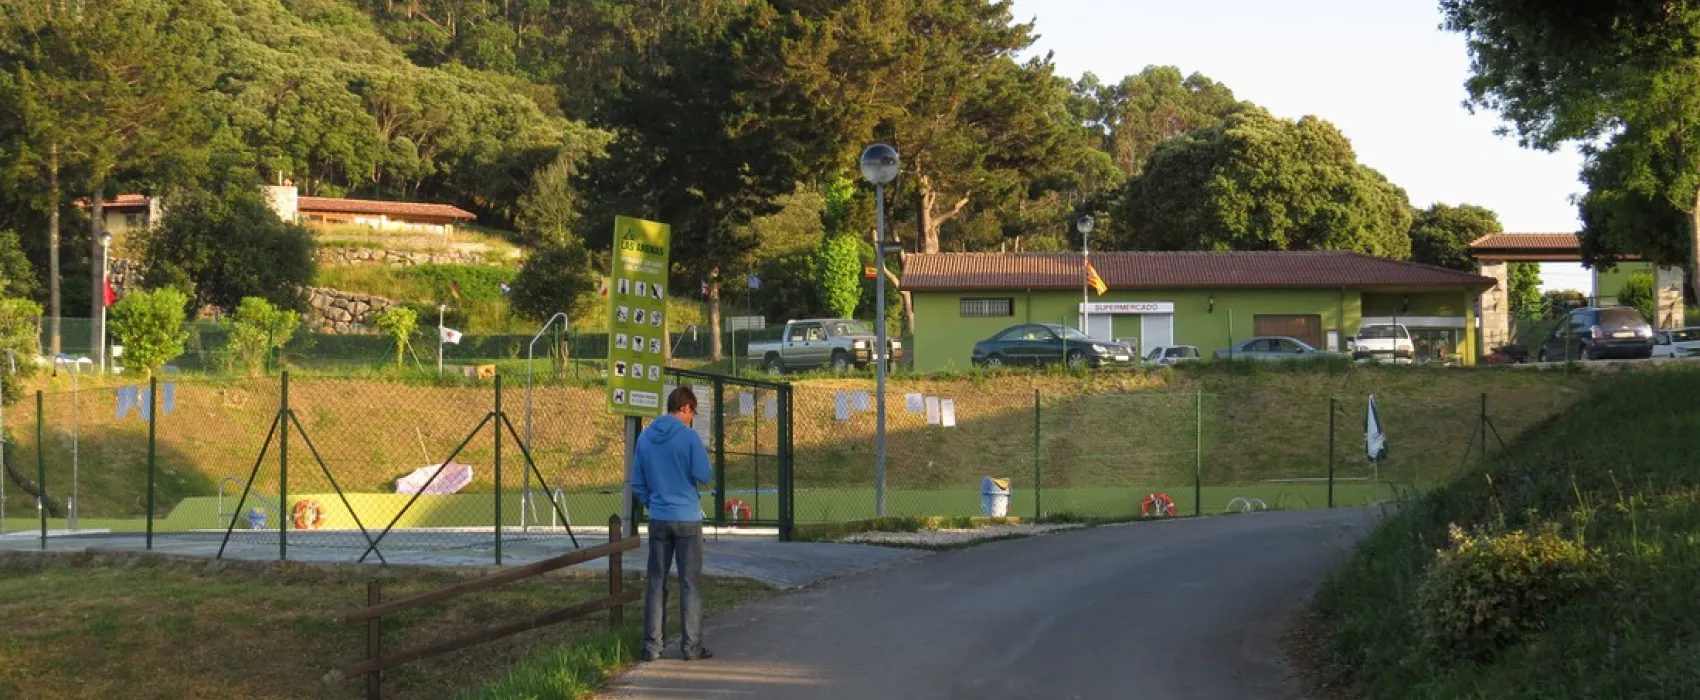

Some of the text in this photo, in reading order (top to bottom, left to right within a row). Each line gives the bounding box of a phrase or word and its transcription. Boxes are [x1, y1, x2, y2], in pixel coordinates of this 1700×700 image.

[620, 240, 664, 256] LAS ARENAS
[1094, 303, 1158, 312] SUPERMERCADO
